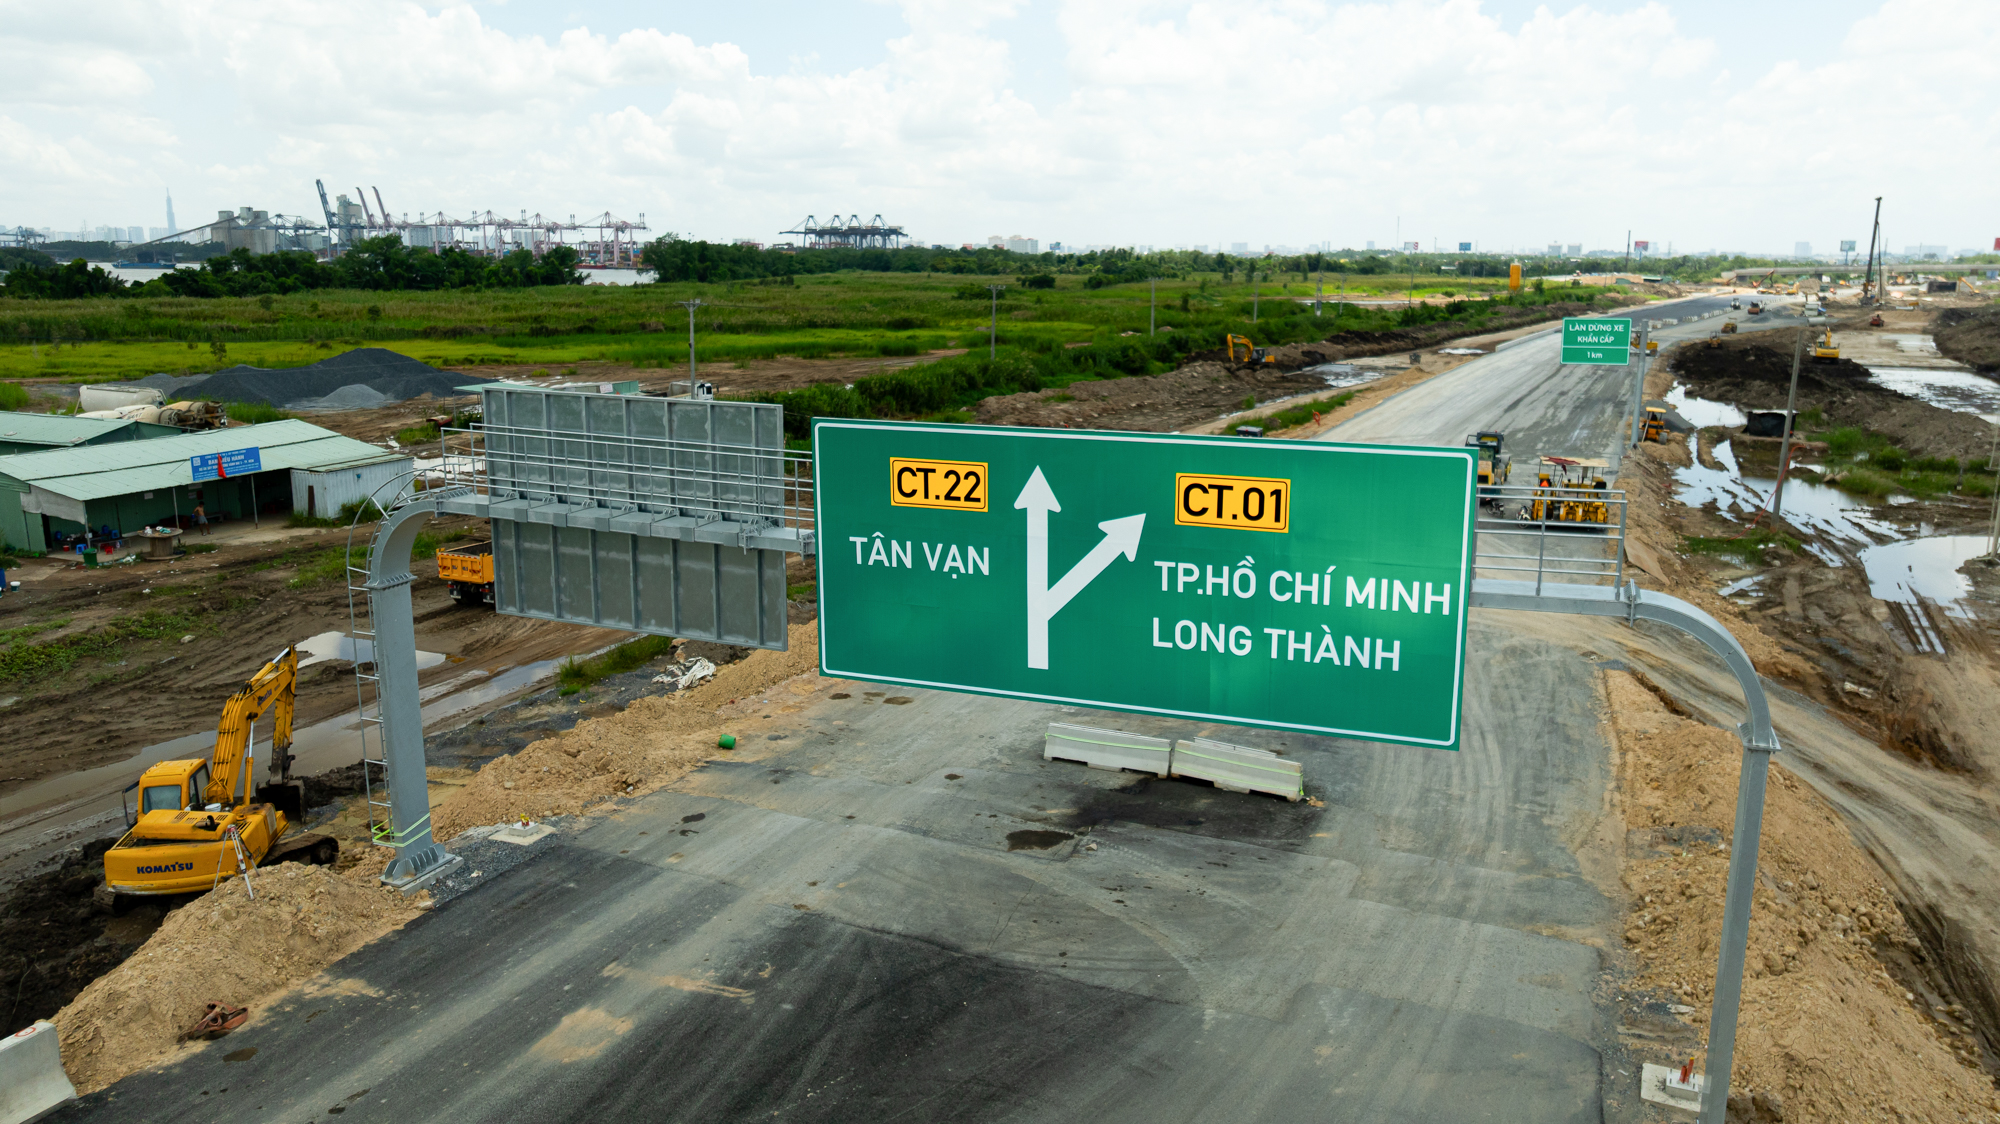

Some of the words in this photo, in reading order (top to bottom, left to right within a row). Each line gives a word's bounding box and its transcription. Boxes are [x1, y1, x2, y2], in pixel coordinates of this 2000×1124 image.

[1569, 322, 1586, 332] LÀN
[1588, 322, 1612, 332] DỪNG
[1613, 324, 1624, 332] XE
[1599, 333, 1614, 343] CẤP
[897, 466, 981, 503] CT.22
[1183, 483, 1282, 523] CT.01
[849, 531, 912, 569] TÂN
[922, 542, 989, 580] VẠN
[1154, 556, 1256, 599] TP.HỒ
[1269, 566, 1337, 606] CHÍ
[1345, 575, 1451, 616] MINH
[1153, 617, 1252, 656] LONG
[1263, 624, 1401, 672] THÀNH
[136, 861, 194, 874] KOMATSU
